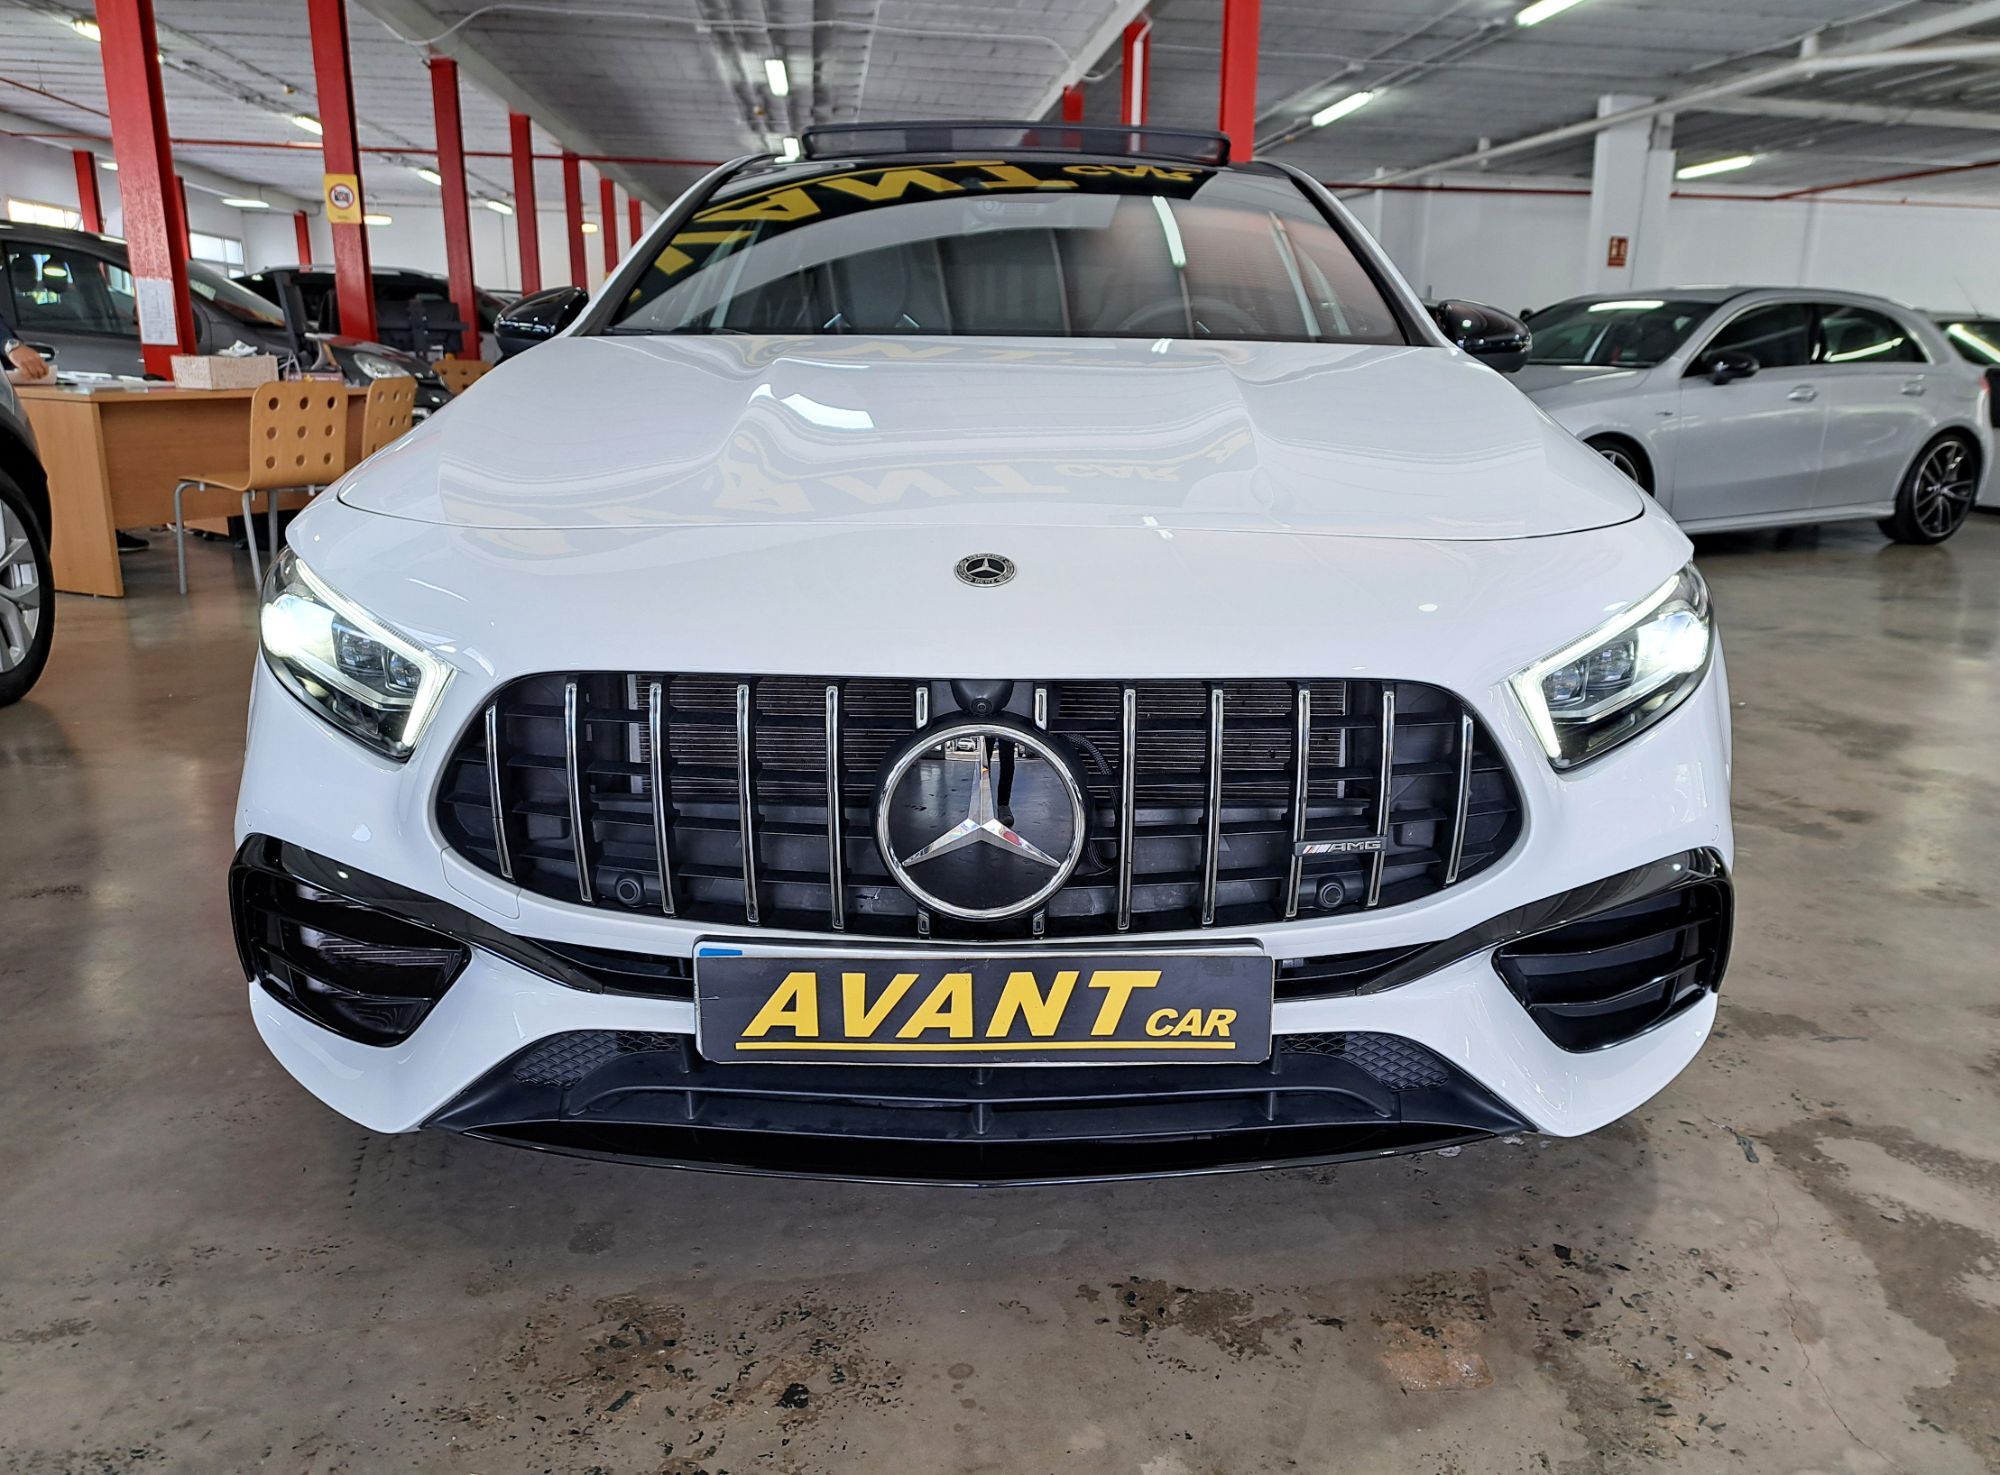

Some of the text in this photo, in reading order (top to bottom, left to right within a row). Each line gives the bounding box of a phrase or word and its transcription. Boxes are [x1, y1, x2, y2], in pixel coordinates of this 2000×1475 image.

[1327, 841, 1382, 853] AMG
[741, 970, 1238, 1038] AVANT CAR
